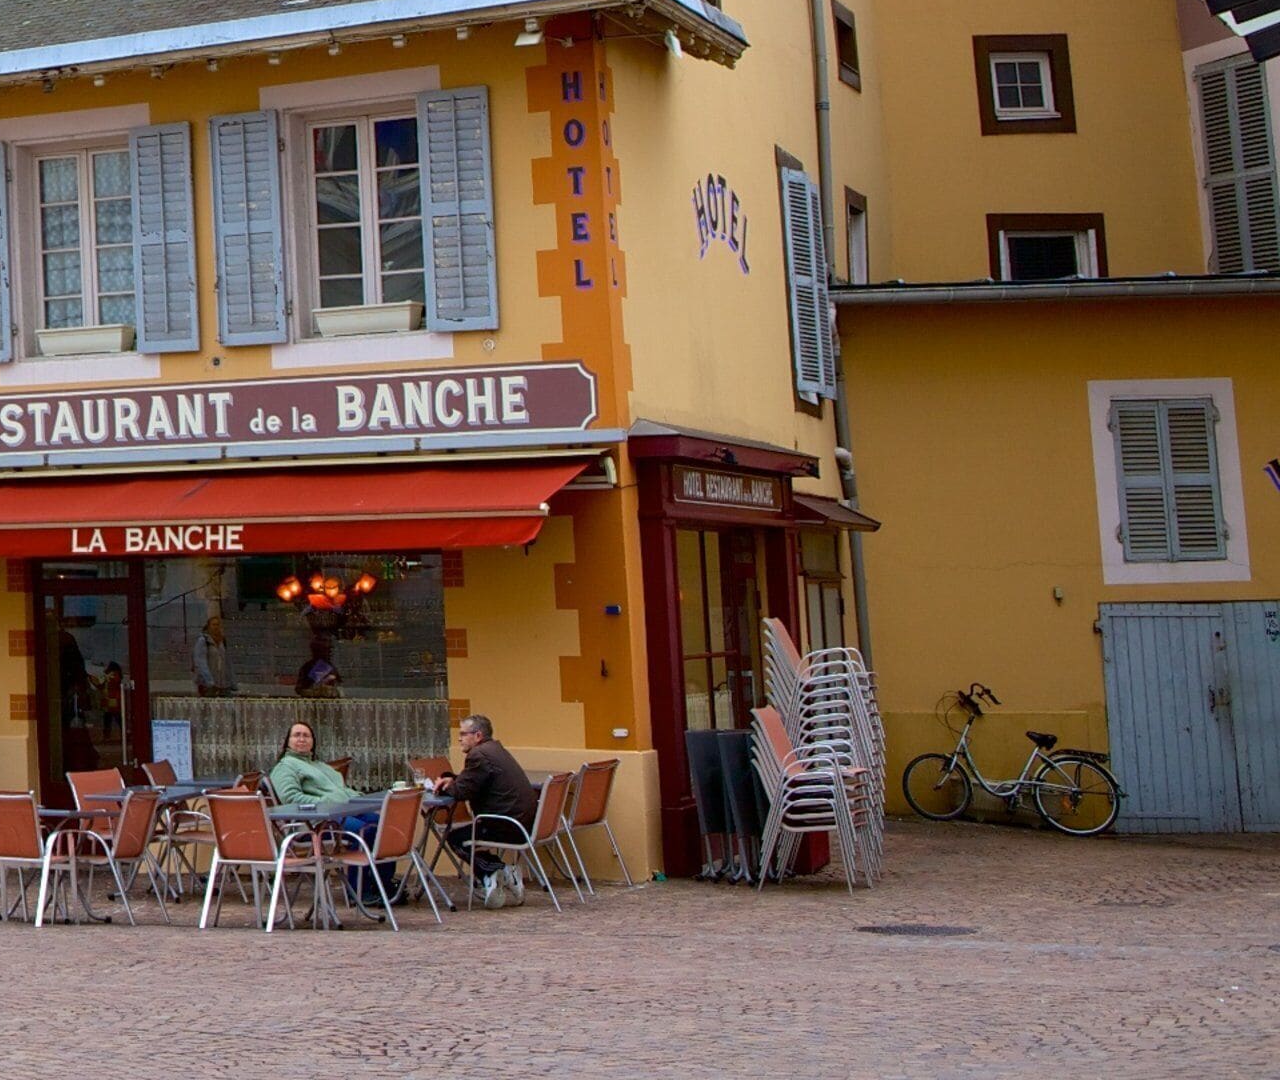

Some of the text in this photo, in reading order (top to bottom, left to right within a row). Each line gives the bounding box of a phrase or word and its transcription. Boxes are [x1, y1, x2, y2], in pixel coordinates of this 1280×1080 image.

[561, 71, 593, 288] HOTEL
[598, 72, 618, 287] HOTEL
[693, 172, 750, 275] HOTEL
[250, 408, 283, 434] de
[291, 406, 318, 433] la
[336, 375, 530, 431] BANCHE
[71, 524, 244, 553] LA BANCHE
